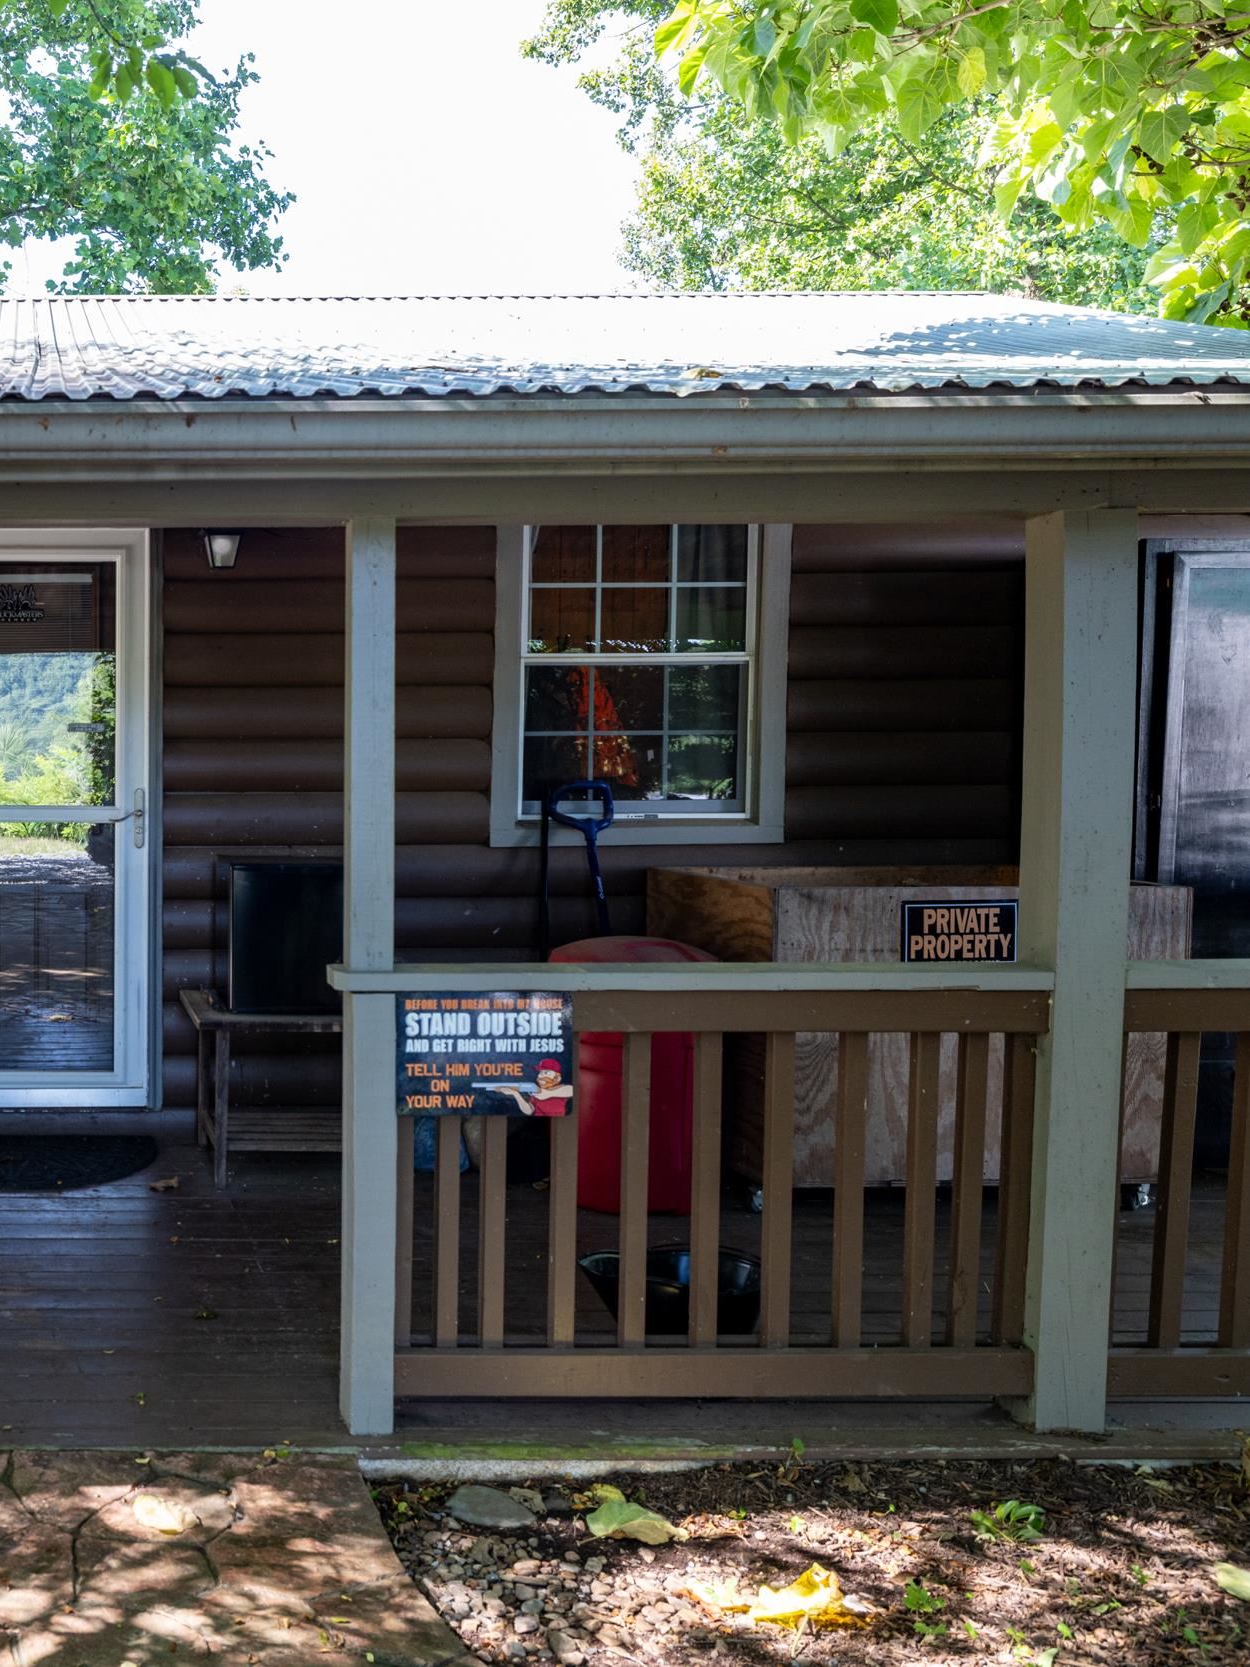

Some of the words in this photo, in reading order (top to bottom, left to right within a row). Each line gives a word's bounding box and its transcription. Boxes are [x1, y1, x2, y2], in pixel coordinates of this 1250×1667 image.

[923, 908, 1000, 933] PRIVATE
[910, 934, 1012, 959] PROPERTY
[405, 999, 438, 1010] BEFORE
[441, 999, 459, 1010] YOU
[461, 999, 490, 1010] BREAK
[493, 999, 514, 1009] INTO
[405, 1012, 471, 1037] STAND
[477, 1012, 563, 1036] OUTSIDE
[405, 1039, 429, 1053] AND
[432, 1039, 454, 1053] GET
[457, 1039, 492, 1052] RIGHT
[494, 1039, 527, 1052] WITH
[529, 1038, 564, 1053] JESUS
[405, 1063, 442, 1077] TELL
[446, 1063, 470, 1076] HIM
[474, 1063, 523, 1076] YOU'RE
[430, 1080, 450, 1092] ON
[405, 1096, 442, 1109] YOUR
[446, 1096, 475, 1108] WAY
